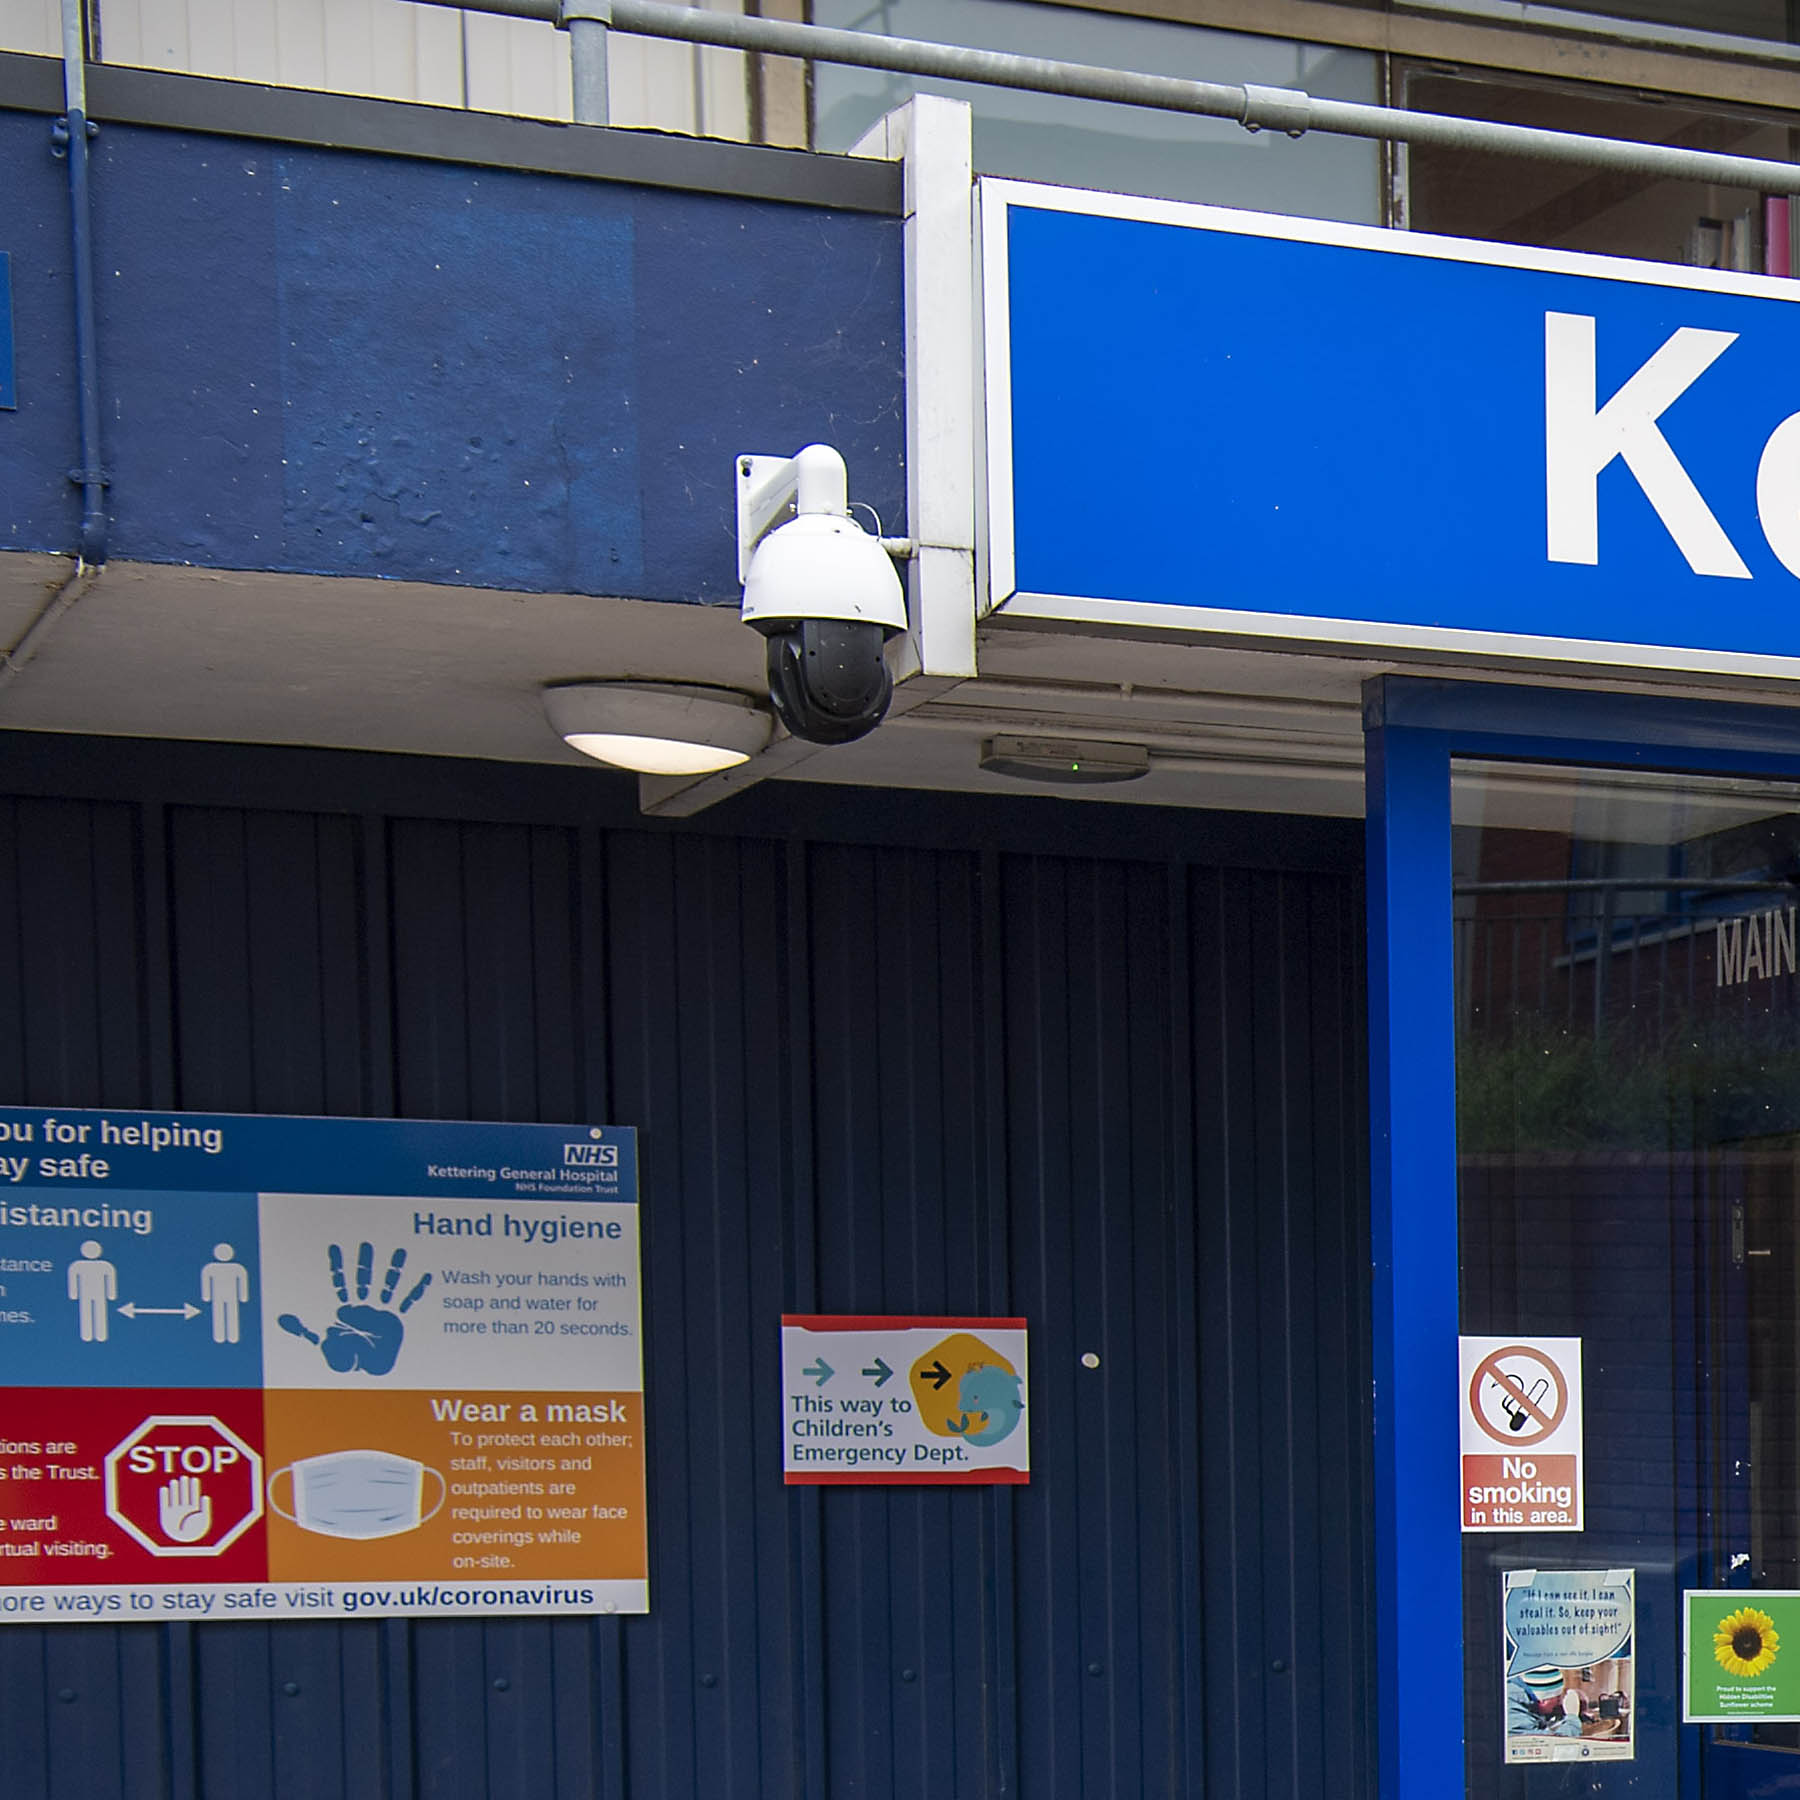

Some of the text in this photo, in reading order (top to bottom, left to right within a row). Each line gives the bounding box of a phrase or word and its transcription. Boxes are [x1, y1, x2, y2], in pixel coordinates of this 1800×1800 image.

[1716, 906, 1796, 987] MAIN
[44, 1119, 91, 1144] for
[100, 1119, 223, 1154] helping
[565, 1146, 616, 1164] NHS
[39, 1154, 110, 1178] safe
[427, 1165, 618, 1183] Kettering General Hospital
[413, 1212, 622, 1244] Hand hygiene
[441, 1270, 626, 1288] Wash your hands with
[443, 1297, 598, 1312] soap and water for
[444, 1321, 633, 1336] more than 20 seconds.
[430, 1399, 627, 1423] Wear a mask
[790, 1395, 912, 1418] This way to
[791, 1418, 894, 1437] Children's
[46, 1442, 77, 1455] are
[450, 1432, 472, 1446] To
[477, 1433, 536, 1448] protect
[540, 1432, 581, 1447] each
[128, 1446, 240, 1473] STOP
[792, 1444, 969, 1465] Emergency Dept.
[12, 1464, 42, 1479] the
[47, 1464, 101, 1480] Trust.
[450, 1456, 592, 1472] staff, visitors and
[1502, 1457, 1537, 1480] No
[451, 1481, 576, 1497] outpatients are
[1468, 1482, 1572, 1509] smoking
[451, 1505, 628, 1522] required to wear face
[1471, 1509, 1573, 1524] in this area.
[10, 1515, 58, 1531] ward
[452, 1529, 581, 1547] coverings while
[43, 1541, 114, 1560] visiting.
[453, 1554, 516, 1568] on-site.
[0, 1585, 594, 1614] ore ways to stay safe visit gov.uk/coronavirus
[1519, 1606, 1544, 1618] steal
[1574, 1606, 1596, 1619] keep
[1598, 1607, 1618, 1618] your
[1515, 1624, 1559, 1637] valuables
[1561, 1624, 1576, 1636] out
[1579, 1623, 1590, 1636] of
